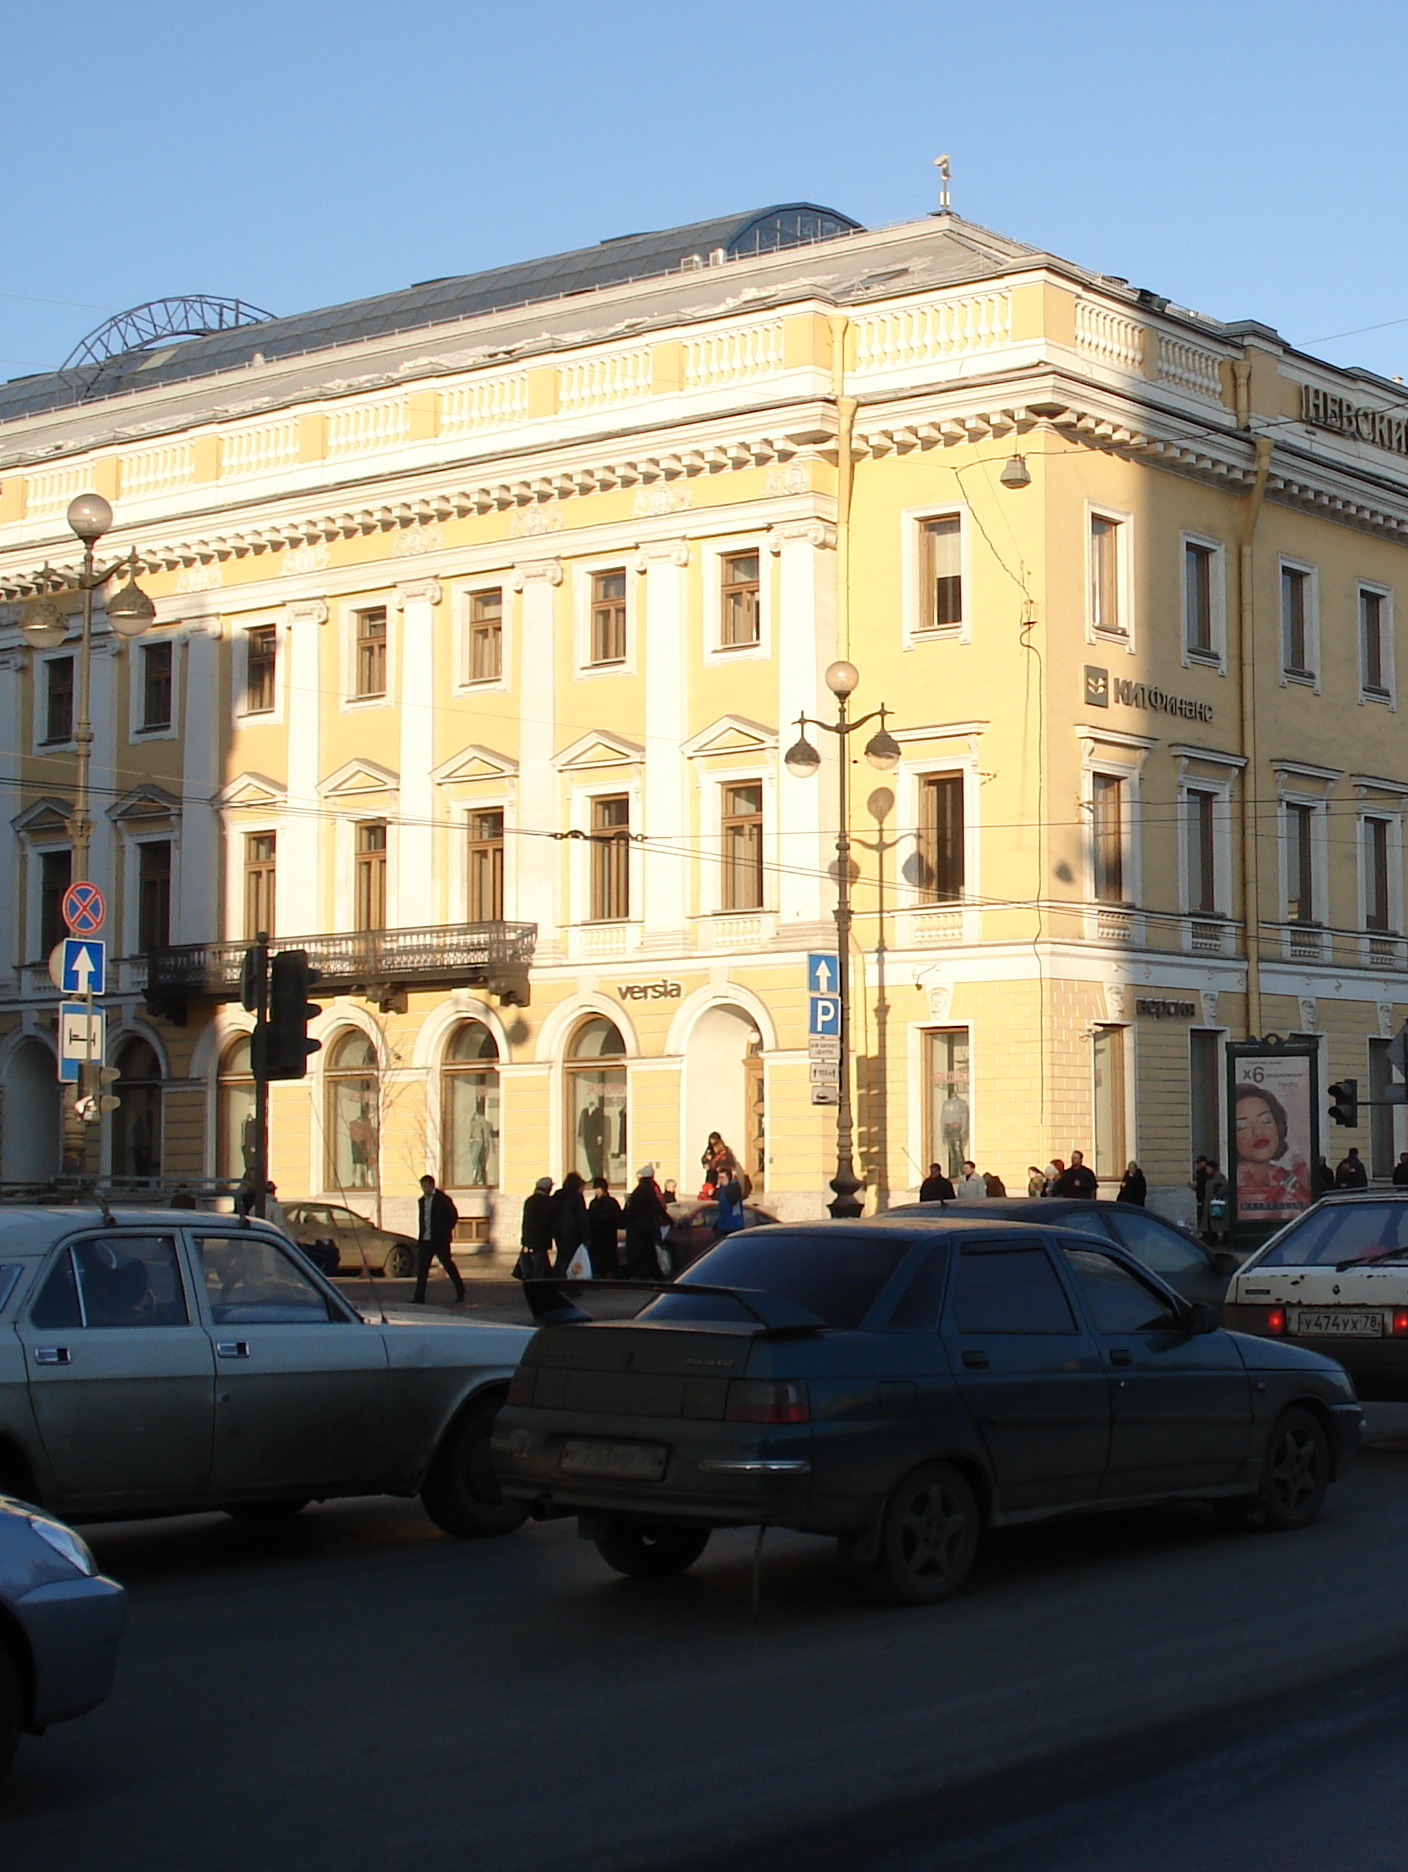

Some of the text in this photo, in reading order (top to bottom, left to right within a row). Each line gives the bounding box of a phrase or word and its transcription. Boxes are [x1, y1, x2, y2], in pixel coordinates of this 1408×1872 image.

[617, 978, 682, 1002] versia
[816, 1000, 836, 1032] P
[1362, 1314, 1377, 1328] 78
